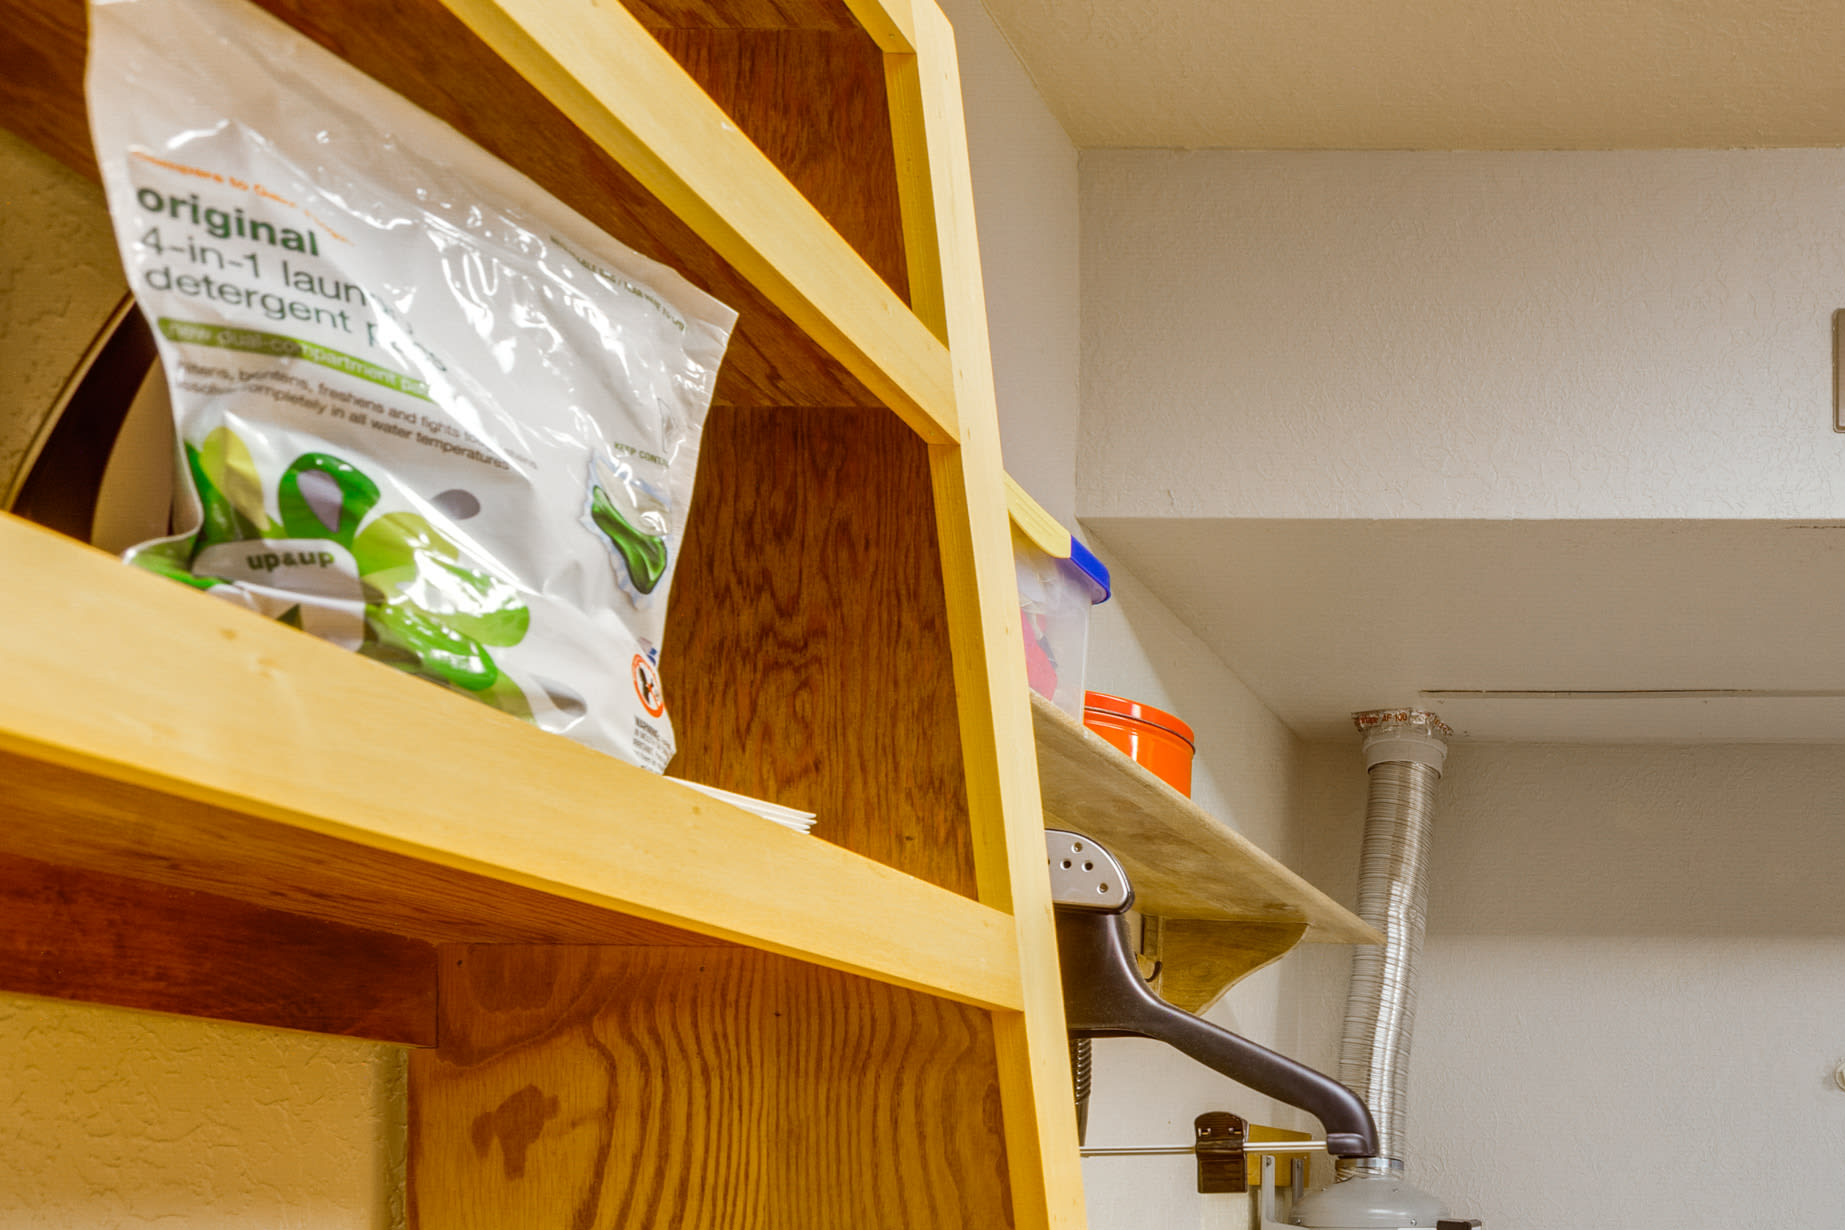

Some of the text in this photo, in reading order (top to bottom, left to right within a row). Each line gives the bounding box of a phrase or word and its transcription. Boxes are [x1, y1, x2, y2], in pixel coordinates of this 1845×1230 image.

[137, 186, 320, 258] original
[141, 226, 261, 279] 4-in-1
[145, 267, 353, 334] detergent
[318, 383, 385, 414] freshens
[388, 406, 417, 424] and
[421, 415, 460, 438] fights
[331, 405, 346, 419] in
[350, 412, 366, 425] all
[371, 418, 413, 439] water
[416, 431, 510, 472] temperatures
[246, 551, 335, 573] up&up
[1395, 712, 1408, 722] 100
